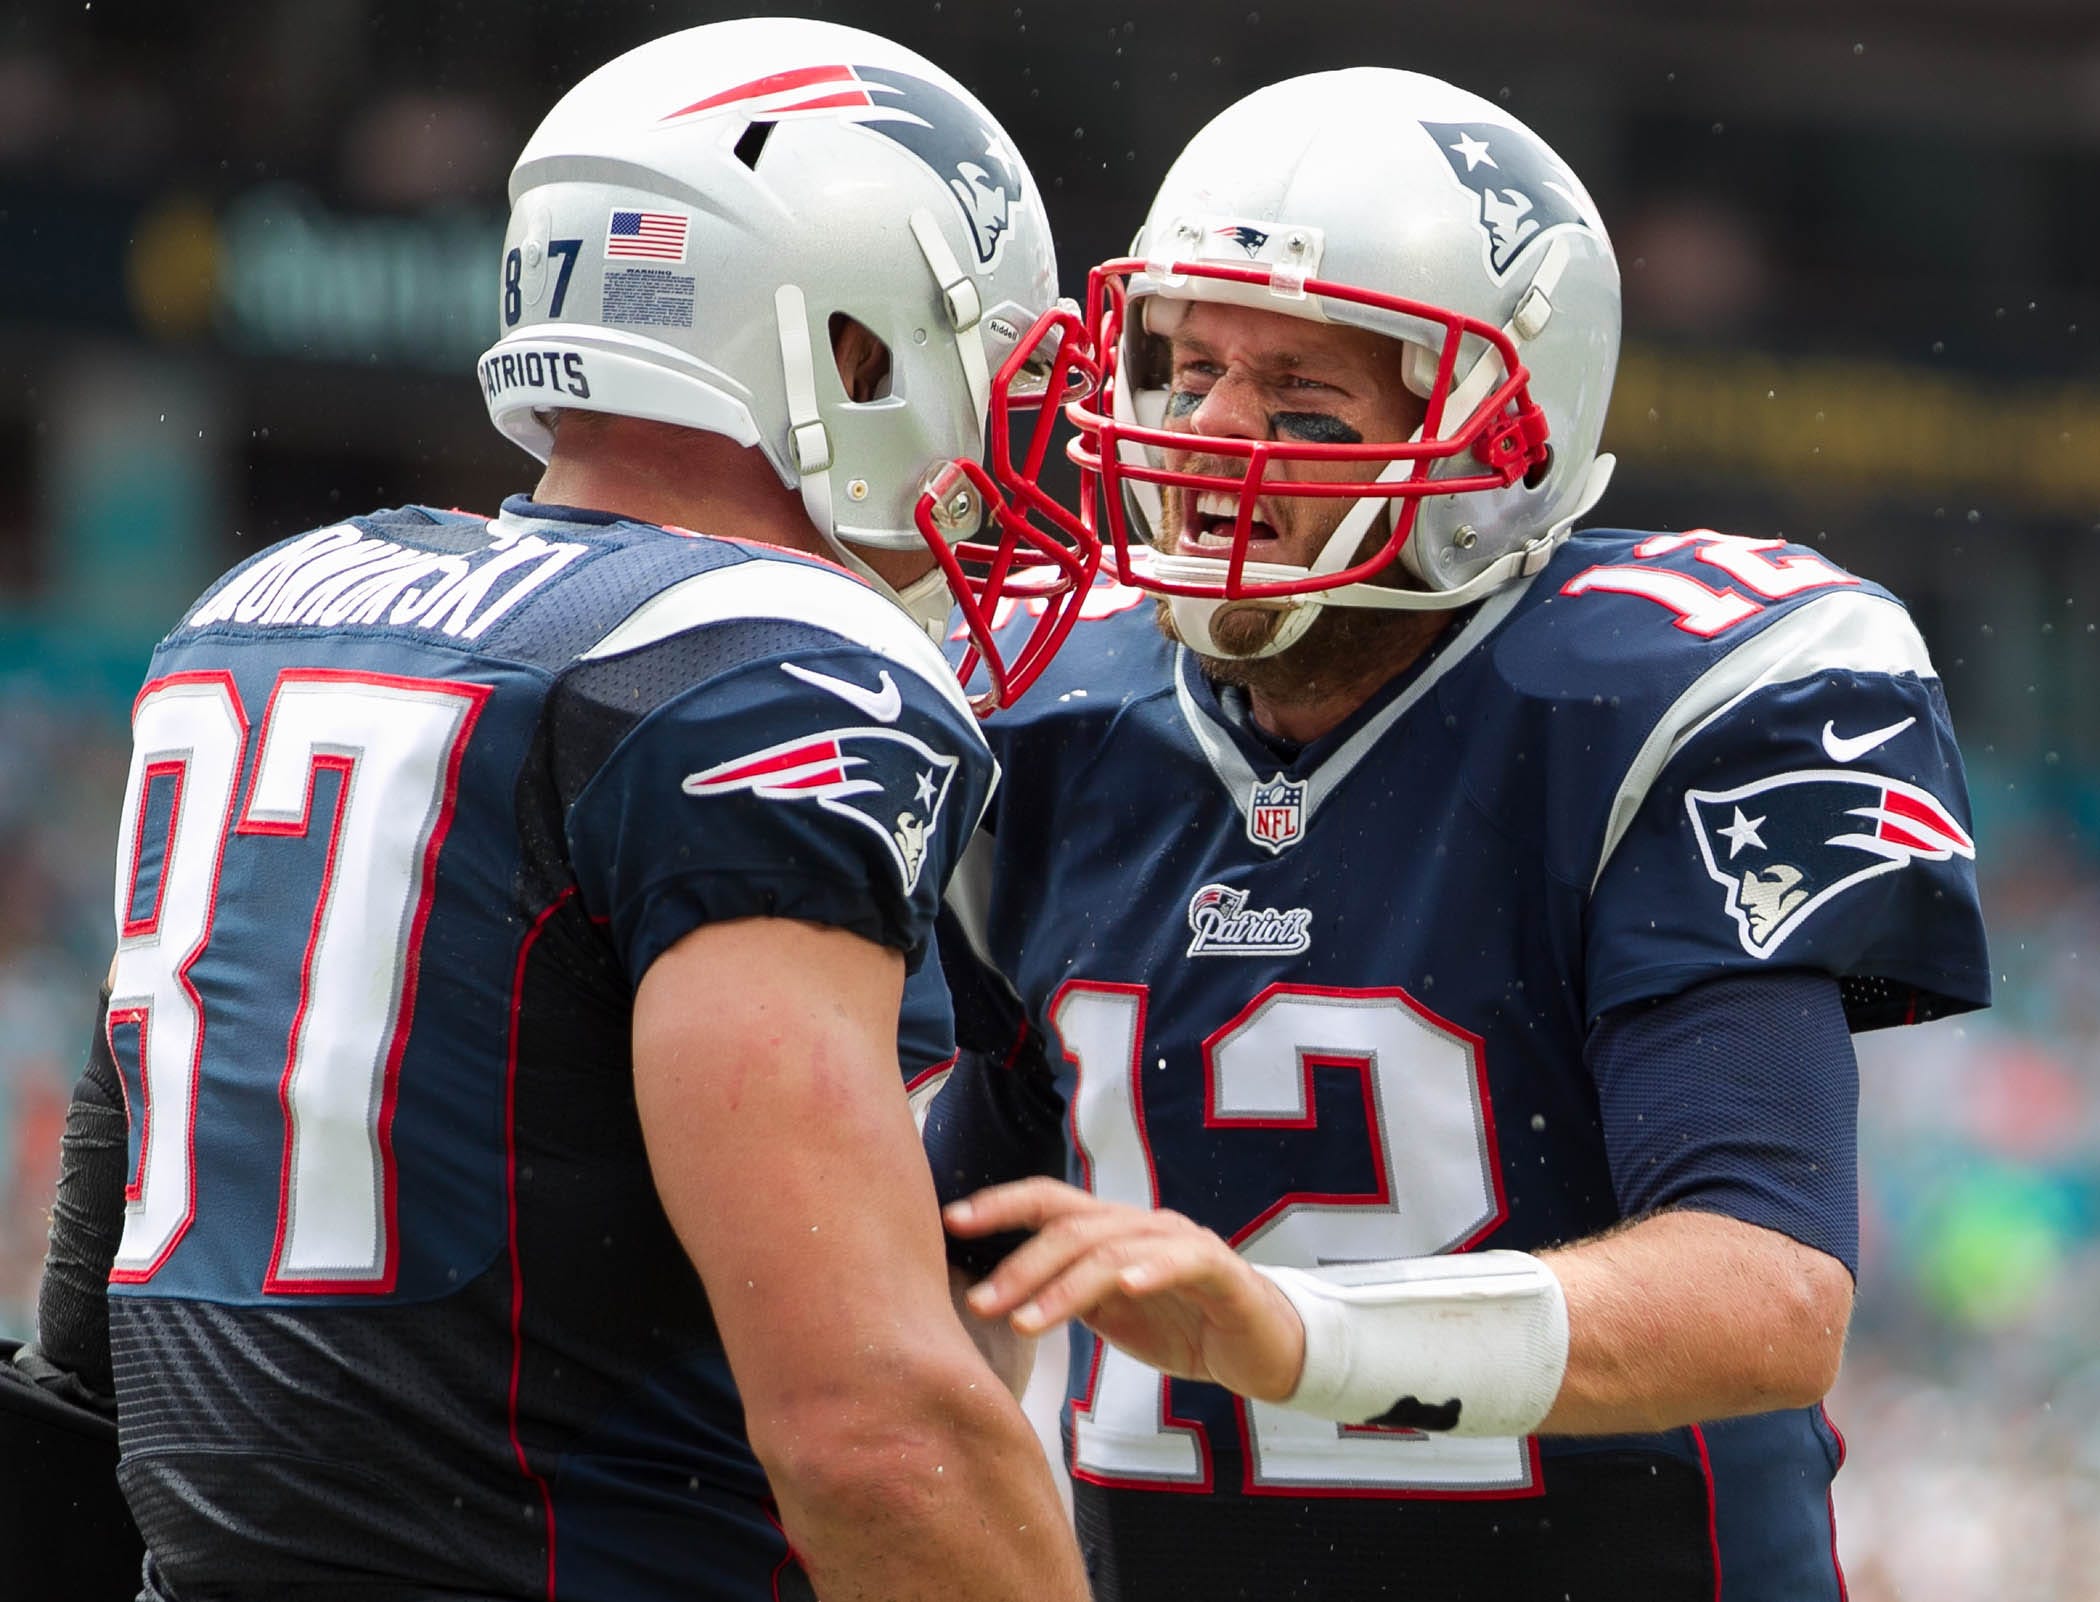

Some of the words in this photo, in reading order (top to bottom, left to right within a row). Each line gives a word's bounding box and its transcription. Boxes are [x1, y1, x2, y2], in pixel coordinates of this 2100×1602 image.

[626, 268, 672, 277] WARNING
[990, 321, 1017, 341] Riddell
[1559, 529, 1861, 639] 12
[1256, 808, 1296, 840] NFL
[1194, 902, 1307, 951] Patriots
[107, 667, 495, 1295] 87
[1048, 979, 1545, 1501] 12
